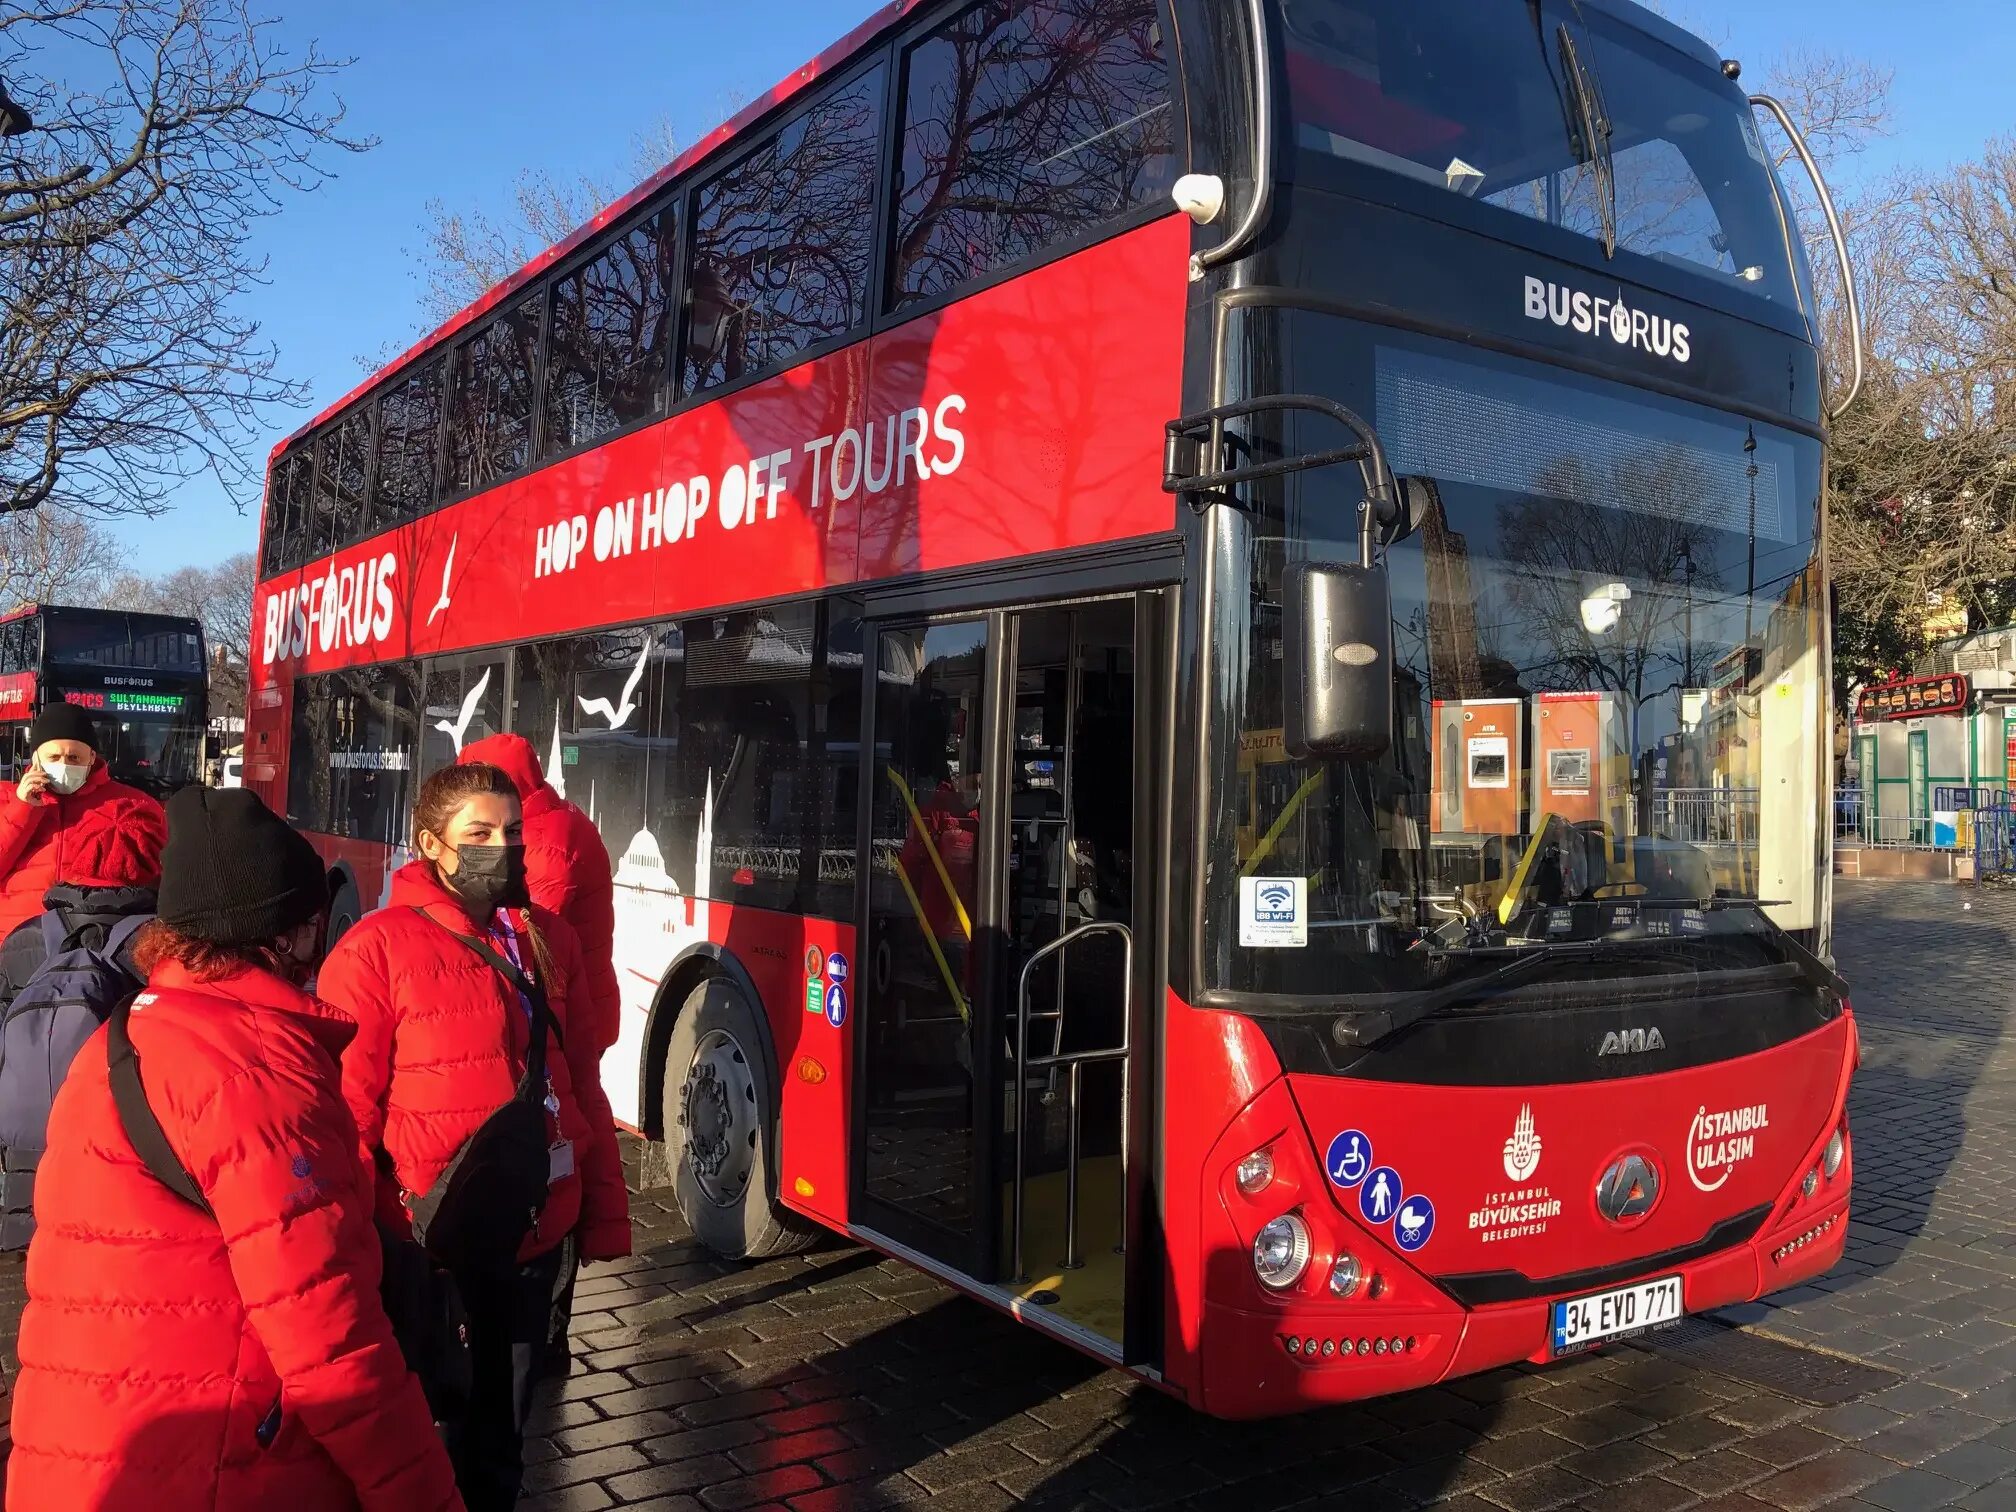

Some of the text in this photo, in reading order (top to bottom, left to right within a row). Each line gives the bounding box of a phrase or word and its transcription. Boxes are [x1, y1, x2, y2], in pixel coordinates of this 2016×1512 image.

[1524, 275, 1691, 363] BUSFORUS
[534, 393, 967, 578] HOP ON HOP OFF TOURS
[262, 551, 397, 665] BUSFORUS
[104, 676, 154, 687] BUSFORUS
[110, 693, 184, 706] SULTANAHMET
[329, 744, 411, 771] www.busforus.istanbul
[1598, 1026, 1666, 1056] AKIA
[1698, 1105, 1769, 1141] İSTANBUL
[1697, 1135, 1754, 1173] ULAŞIM
[1485, 1187, 1549, 1205] İSTANBUL
[1468, 1198, 1561, 1229] BÜYÜKŞEHİR
[1482, 1221, 1546, 1242] BELEDİYESİ
[1556, 1282, 1675, 1338] TR 34 EVD 771
